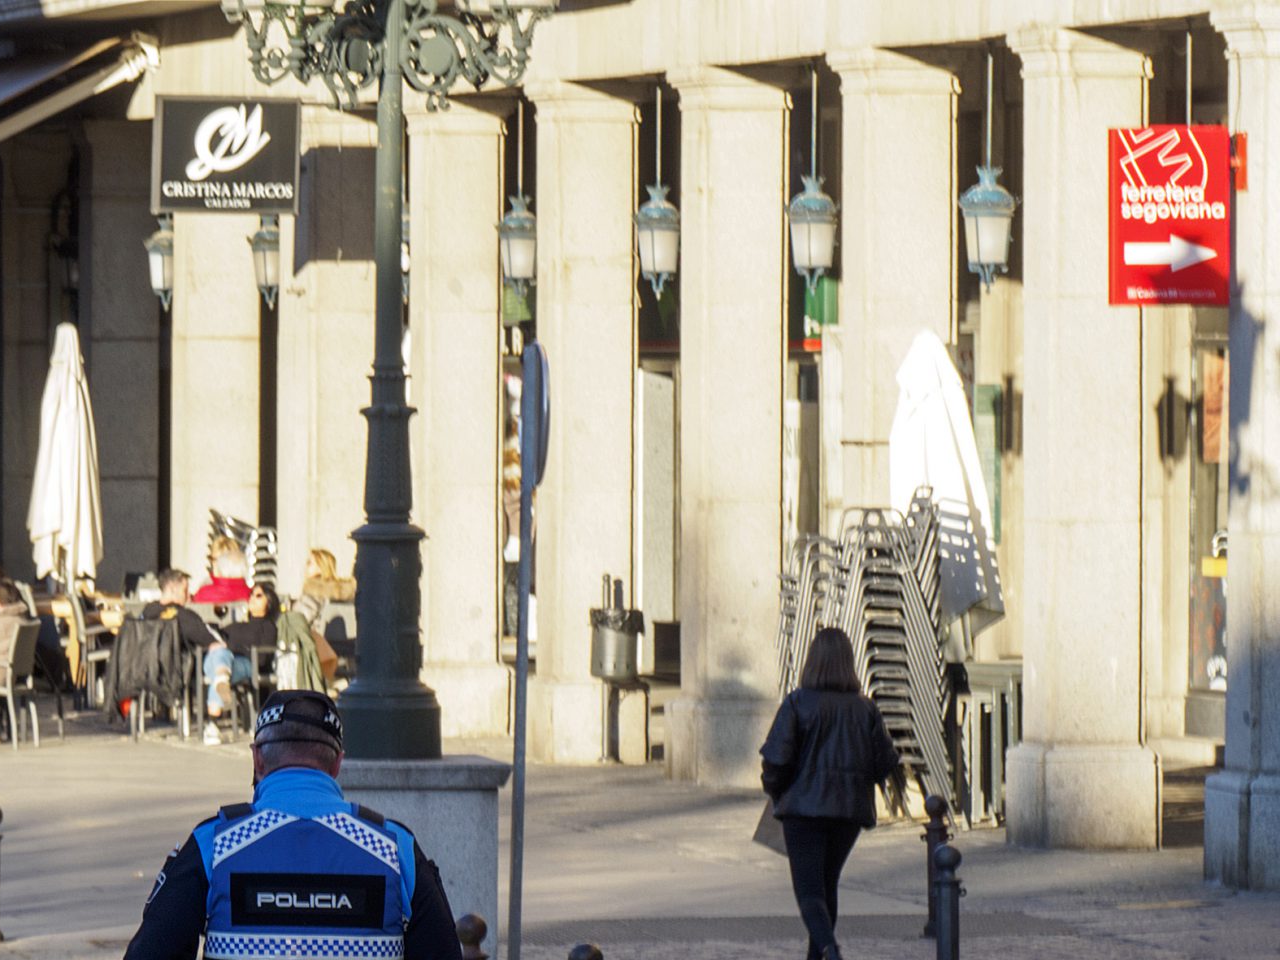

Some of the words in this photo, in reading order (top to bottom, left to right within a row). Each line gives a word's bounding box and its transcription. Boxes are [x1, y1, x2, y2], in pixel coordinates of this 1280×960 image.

[162, 181, 231, 198] CRISTINA
[233, 182, 293, 200] MARCOS
[204, 198, 251, 208] CALZADOS
[1121, 201, 1225, 224] segoviana
[256, 892, 353, 909] POLICIA
